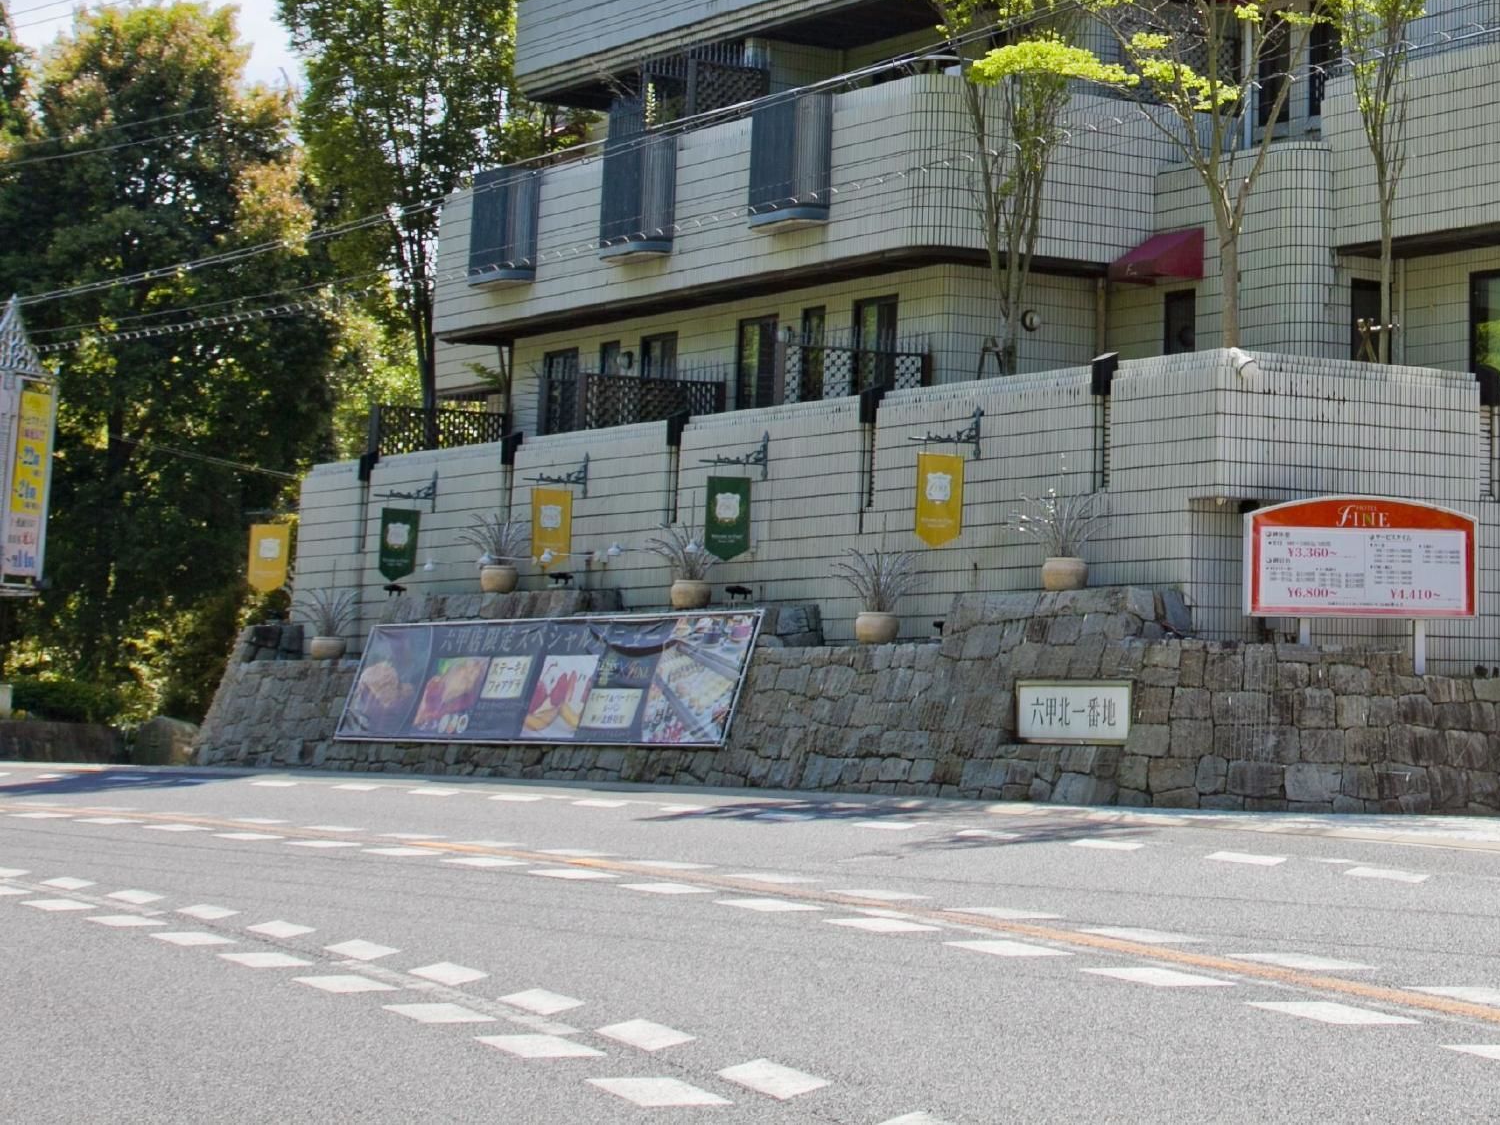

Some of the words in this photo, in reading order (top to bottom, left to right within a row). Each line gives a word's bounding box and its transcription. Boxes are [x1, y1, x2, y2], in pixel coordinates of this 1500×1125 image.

[1335, 504, 1391, 527] FINE
[1031, 696, 1117, 728] 六甲北一番地
